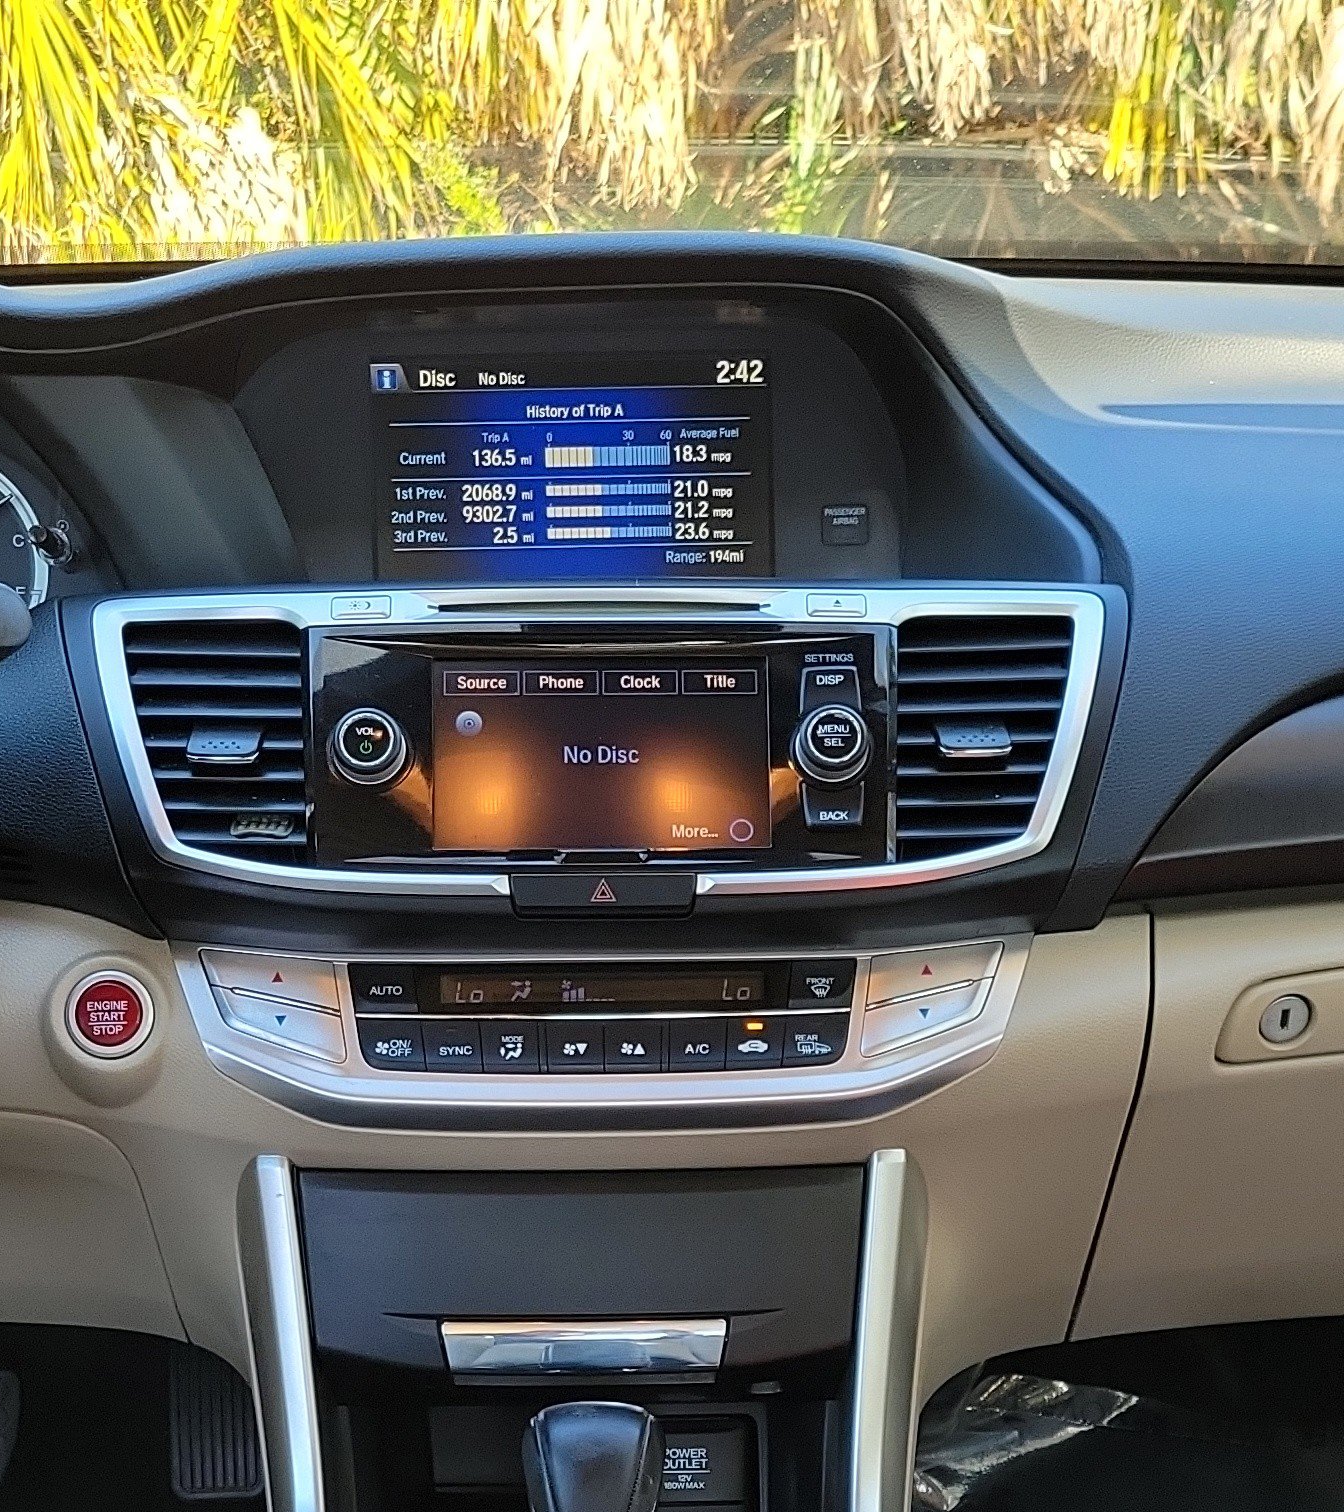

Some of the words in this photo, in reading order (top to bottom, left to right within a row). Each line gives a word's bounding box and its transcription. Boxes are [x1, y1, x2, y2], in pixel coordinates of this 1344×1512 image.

[419, 369, 456, 387] Disc
[716, 359, 763, 384] 2:42
[478, 372, 496, 385] No
[498, 372, 525, 386] Disc
[526, 404, 568, 420] History
[571, 404, 584, 418] of
[587, 404, 611, 420] Trip
[613, 404, 624, 417] A
[482, 432, 499, 445] Trip
[501, 432, 509, 443] A
[546, 432, 553, 442] 0
[622, 430, 634, 441] 30
[659, 429, 672, 440] 60
[679, 428, 717, 440] Average
[720, 427, 739, 439] Fuel
[399, 451, 446, 466] Current
[472, 449, 516, 467] 136.5
[520, 454, 532, 466] mi
[673, 445, 707, 463] 18.3
[711, 451, 731, 464] mpg
[395, 486, 415, 500] 1st
[418, 485, 447, 500] Prev.
[462, 483, 516, 502] 2068.9
[521, 488, 533, 500] mi
[674, 480, 708, 498] 21.0
[712, 486, 732, 499] mpg
[391, 509, 416, 523] 2nd
[419, 509, 448, 523] Prev.
[462, 505, 517, 524] 9302.7
[522, 510, 534, 522] mi
[675, 501, 709, 520] 21.2
[713, 508, 733, 520] mpg
[394, 530, 417, 543] 3rd
[420, 529, 448, 544] Prev.
[493, 526, 518, 545] 2.5
[523, 532, 535, 544] mi
[675, 522, 709, 540] 23.6
[713, 528, 734, 541] mpg
[13, 534, 24, 547] C
[665, 550, 707, 566] Range:
[709, 549, 744, 564] 194mi
[804, 653, 854, 664] SETTINGS
[456, 674, 507, 691] Source
[538, 674, 584, 690] Phone
[619, 673, 660, 690] Clock
[703, 673, 736, 690] Title
[816, 673, 844, 687] DISP
[356, 727, 375, 737] VOL
[817, 723, 850, 734] MENU
[823, 737, 845, 748] SEL
[563, 745, 593, 764] No
[597, 745, 639, 765] Disc
[819, 810, 849, 822] BACK
[671, 823, 718, 839] More...
[806, 977, 835, 986] FRONT
[369, 985, 402, 996] AUTO
[455, 982, 483, 1003] Lo
[722, 979, 750, 1000] Lo
[87, 1001, 128, 1011] ENGINE
[90, 1012, 125, 1021] START
[93, 1025, 123, 1035] STOP
[389, 1039, 413, 1049] ON/
[501, 1035, 524, 1044] MODE
[794, 1034, 818, 1042] REAR
[389, 1046, 413, 1058] OFF
[438, 1045, 473, 1056] SYNC
[684, 1043, 710, 1055] A/C
